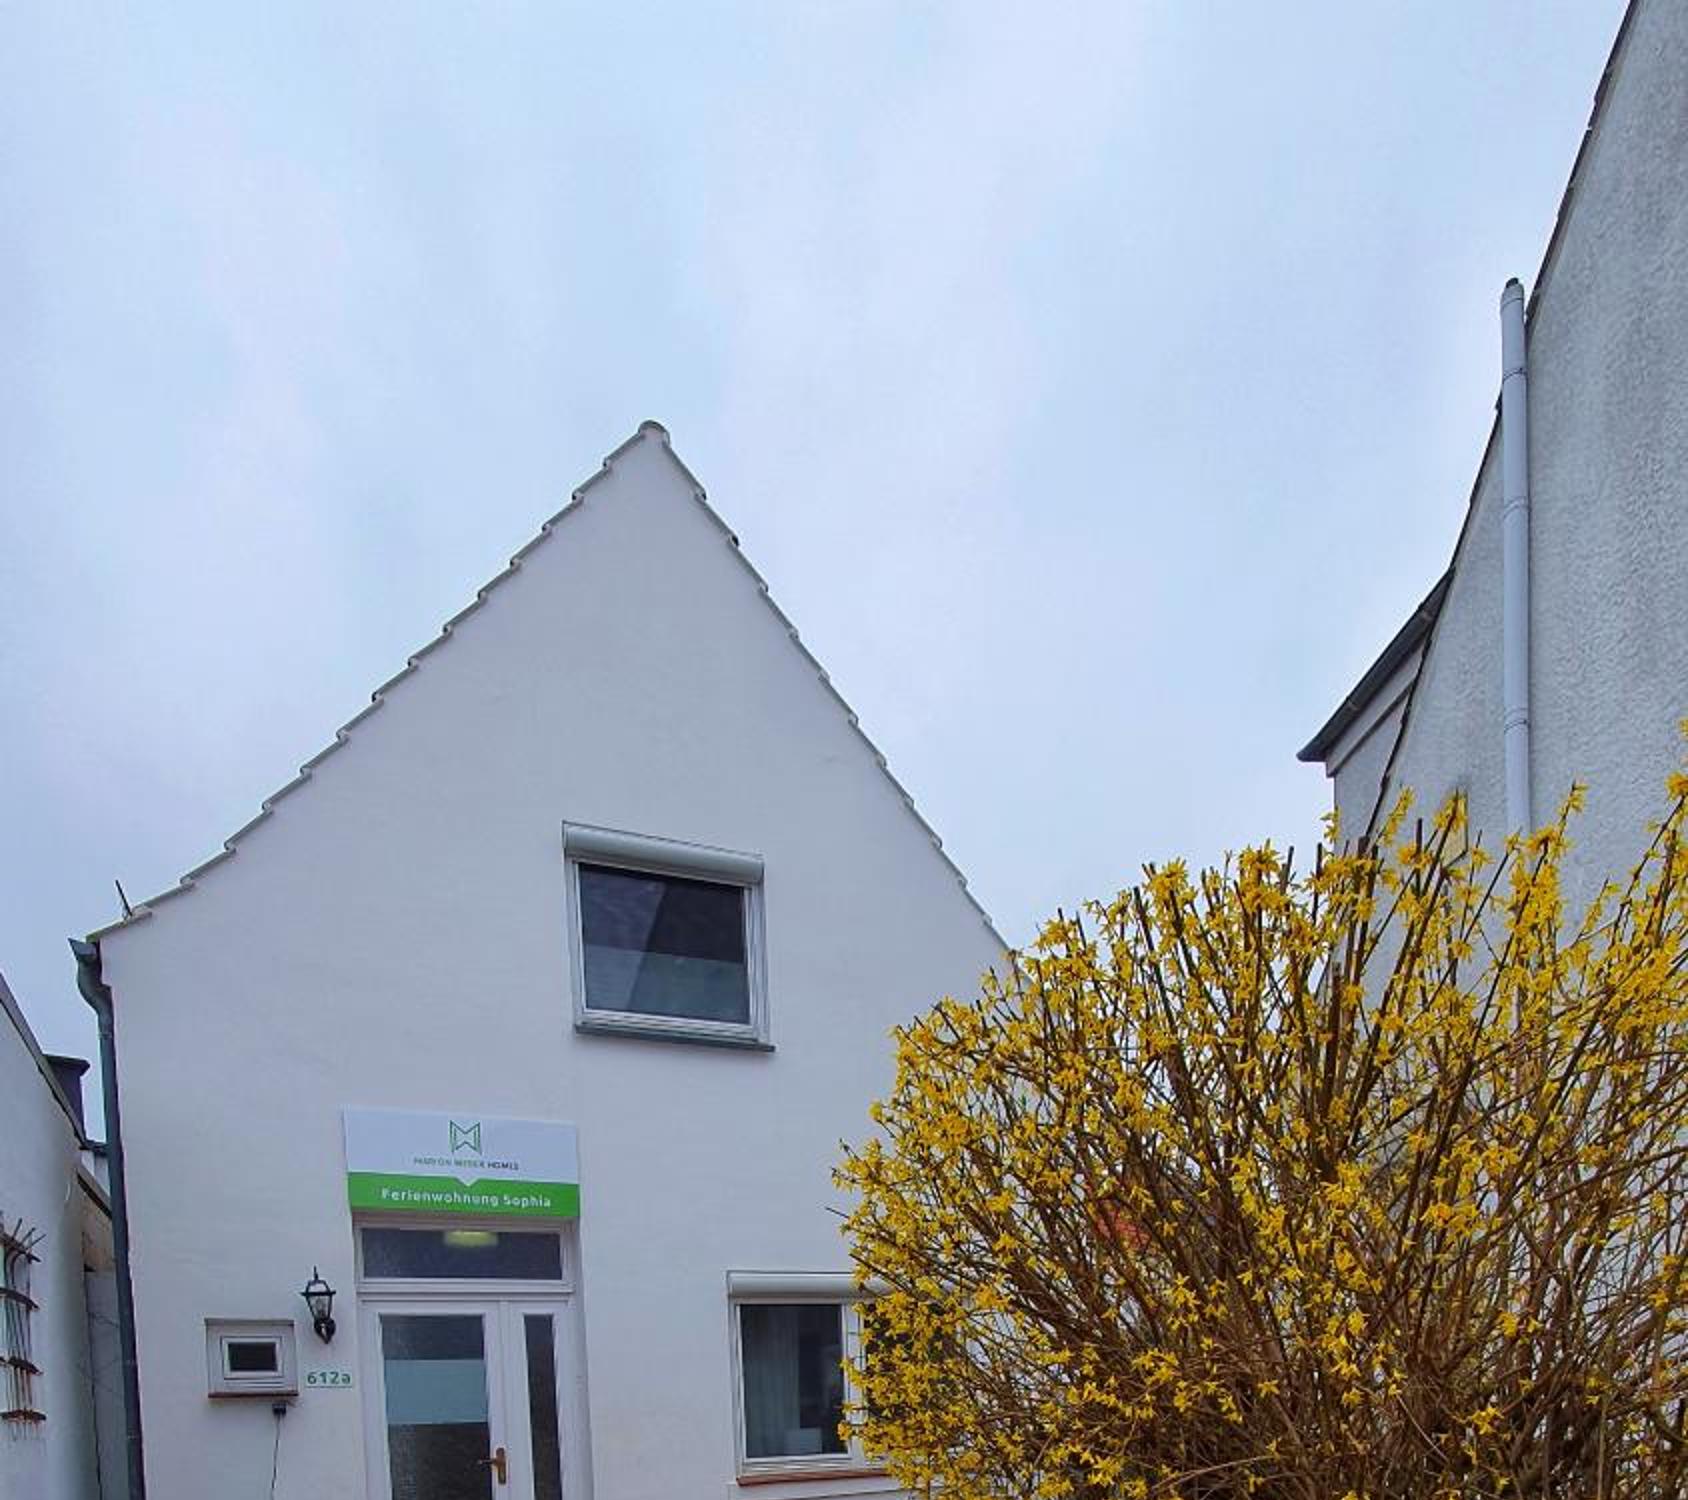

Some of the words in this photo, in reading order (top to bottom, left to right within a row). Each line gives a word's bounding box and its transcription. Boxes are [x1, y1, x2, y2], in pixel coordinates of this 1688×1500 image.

[488, 1160, 520, 1171] HOMES
[381, 1188, 499, 1207] Ferienwohnung
[504, 1195, 551, 1208] Sophia
[308, 1371, 351, 1385] 612a
